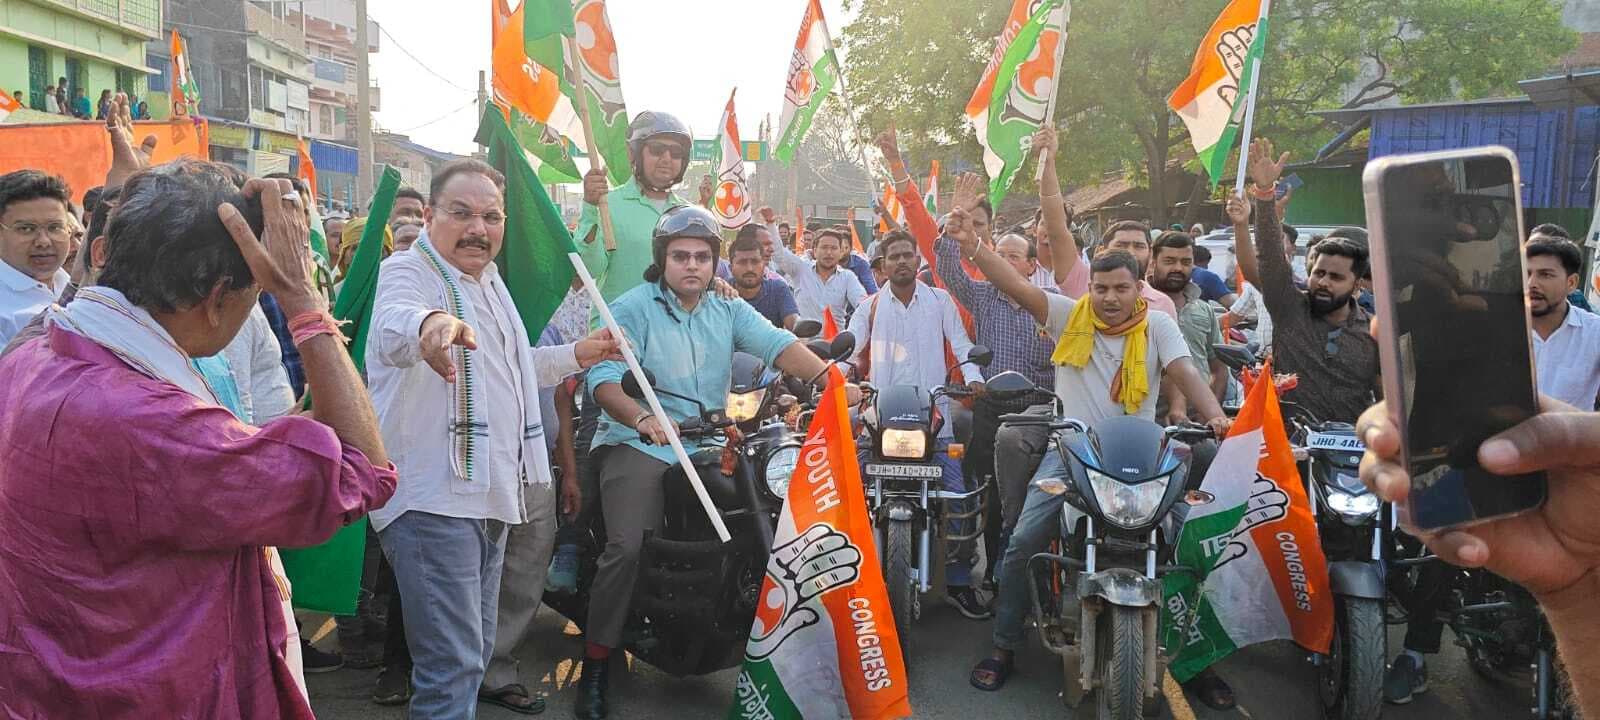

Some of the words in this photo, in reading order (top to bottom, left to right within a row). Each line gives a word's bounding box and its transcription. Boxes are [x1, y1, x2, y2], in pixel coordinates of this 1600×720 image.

[803, 427, 841, 512] YOUTH
[1275, 531, 1312, 611] CONGRESS
[848, 597, 892, 691] CONGRESS
